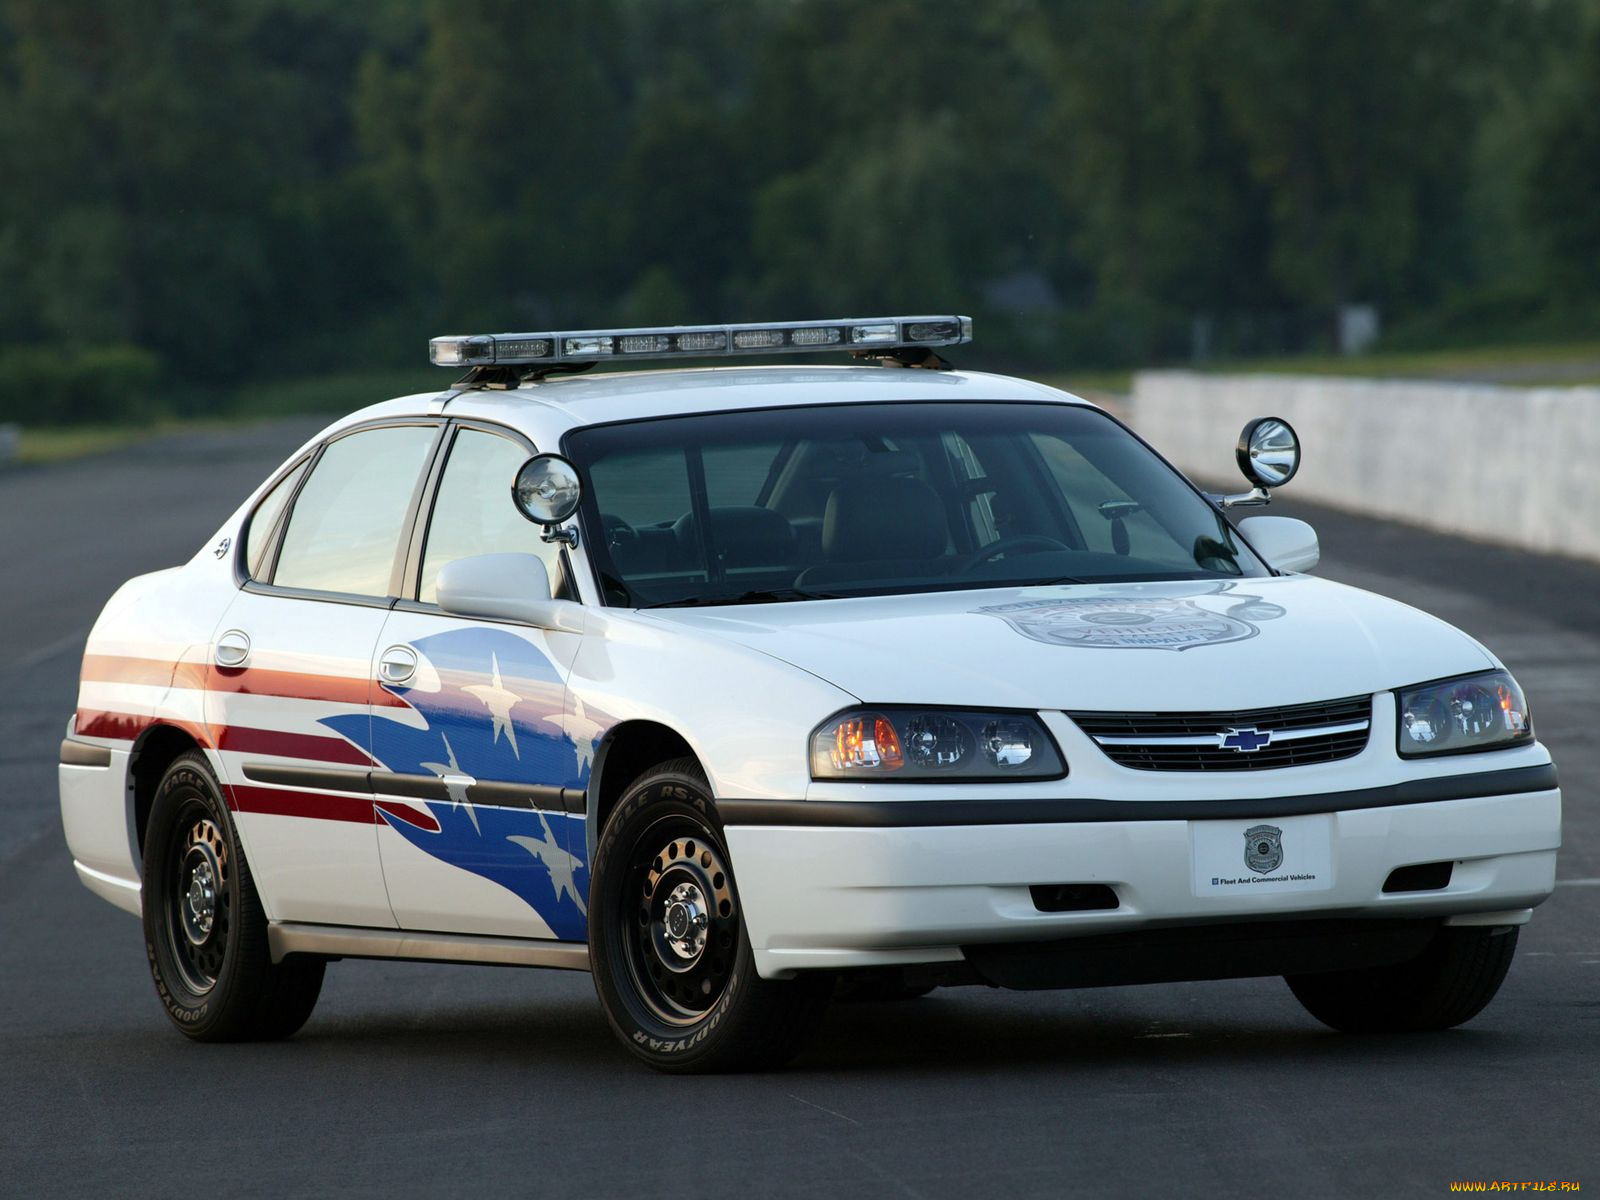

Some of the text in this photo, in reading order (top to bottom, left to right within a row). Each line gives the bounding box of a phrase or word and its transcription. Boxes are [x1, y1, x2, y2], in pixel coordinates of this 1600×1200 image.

[164, 771, 205, 796] EAGLE
[1252, 874, 1289, 883] Commercial
[1289, 873, 1316, 881] Vehicles
[147, 943, 208, 1022] GOODYEAR
[633, 973, 738, 1052] GOODYEAR
